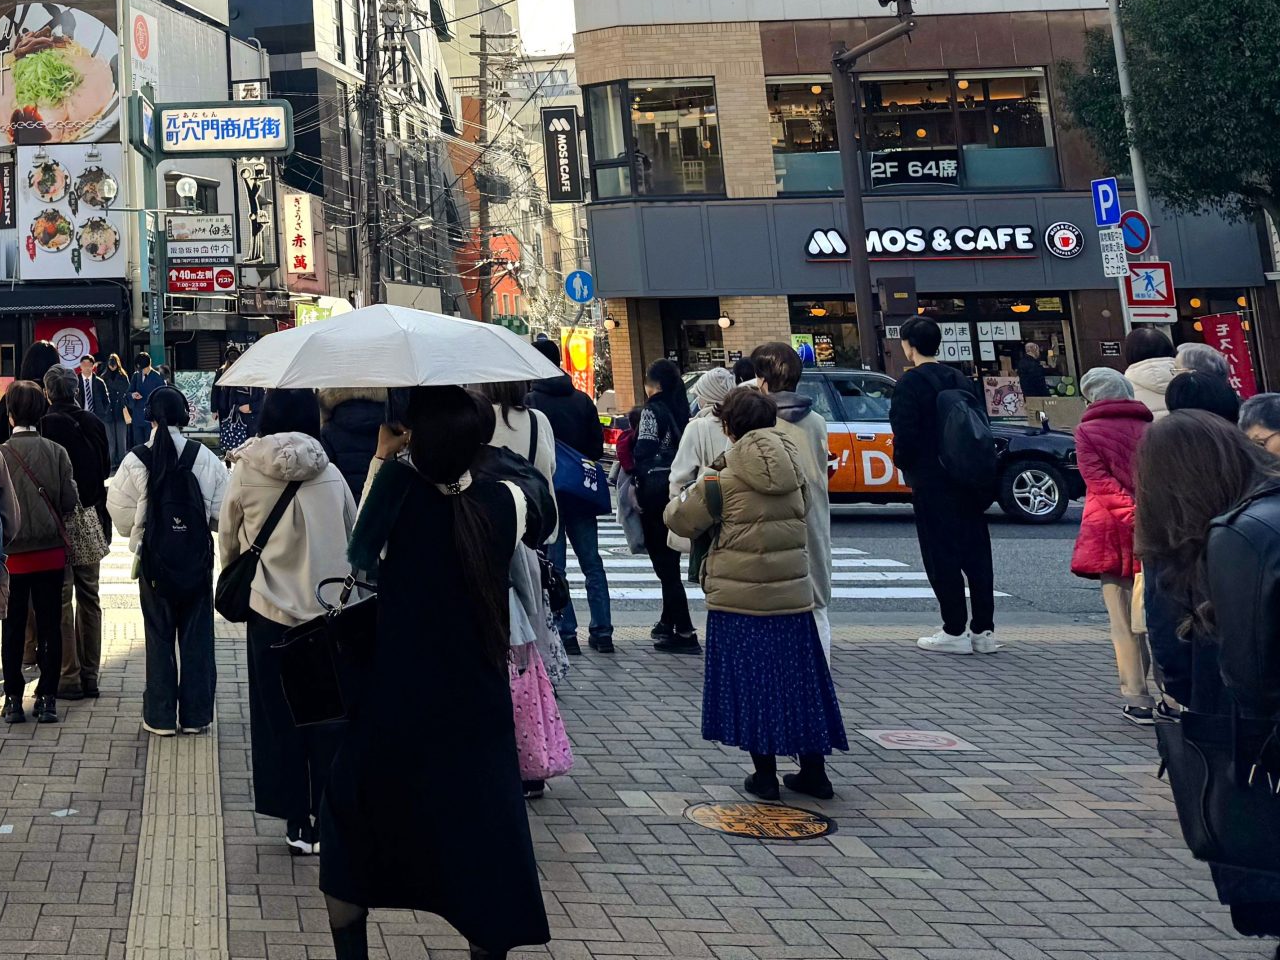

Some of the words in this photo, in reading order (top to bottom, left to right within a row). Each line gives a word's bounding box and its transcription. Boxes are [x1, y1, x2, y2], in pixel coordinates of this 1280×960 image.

[242, 83, 258, 100] 元
[166, 113, 180, 145] 元町
[181, 116, 281, 141] 穴門商店街
[557, 134, 571, 192] MOS&CAFE
[872, 162, 898, 178] 2F
[907, 159, 958, 178] 64席
[293, 197, 303, 231] ぎょうざ
[1097, 183, 1114, 221] P
[292, 233, 308, 271] 赤萬
[865, 228, 926, 253] MOS
[932, 228, 952, 252] &
[954, 227, 1034, 252] CAFE
